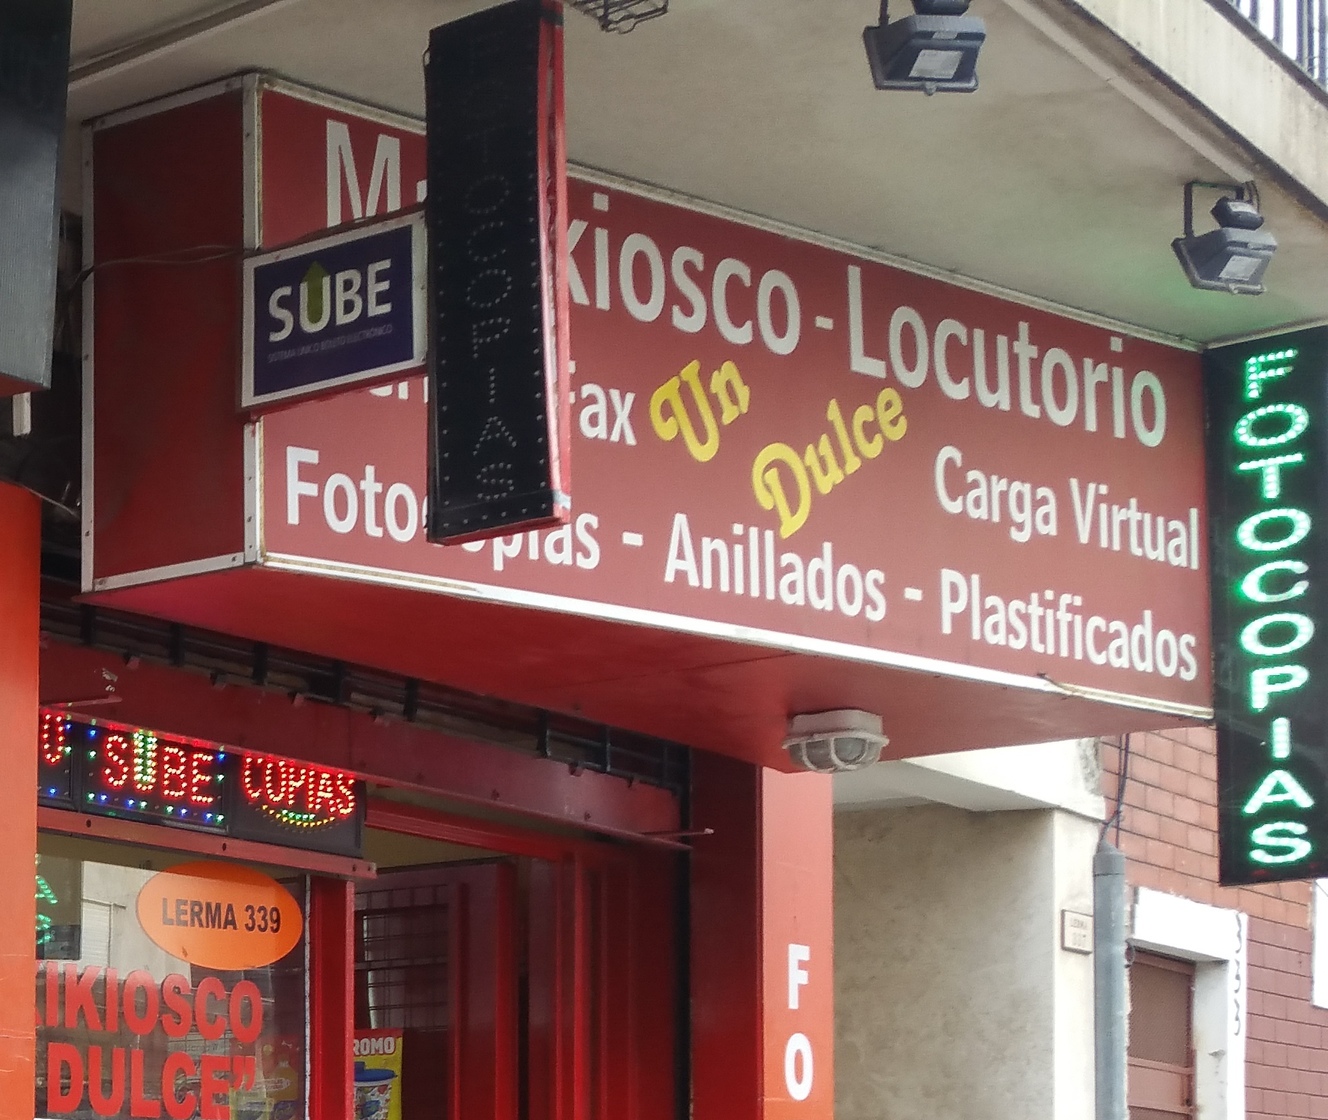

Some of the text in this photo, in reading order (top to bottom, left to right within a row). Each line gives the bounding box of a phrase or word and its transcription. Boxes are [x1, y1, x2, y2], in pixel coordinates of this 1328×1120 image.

[268, 258, 392, 342] SUBE
[568, 360, 637, 446] ax
[650, 359, 750, 462] Un
[752, 387, 907, 538] Dulce
[935, 445, 1200, 571] Carga Virtual
[664, 512, 886, 622] Anillados
[941, 569, 1197, 681] Plastificados
[1233, 347, 1316, 867] FOTOCOPIAS
[104, 730, 214, 804] SUBE
[162, 898, 282, 934] LERMA 339
[35, 960, 264, 1043] IKIOSCO
